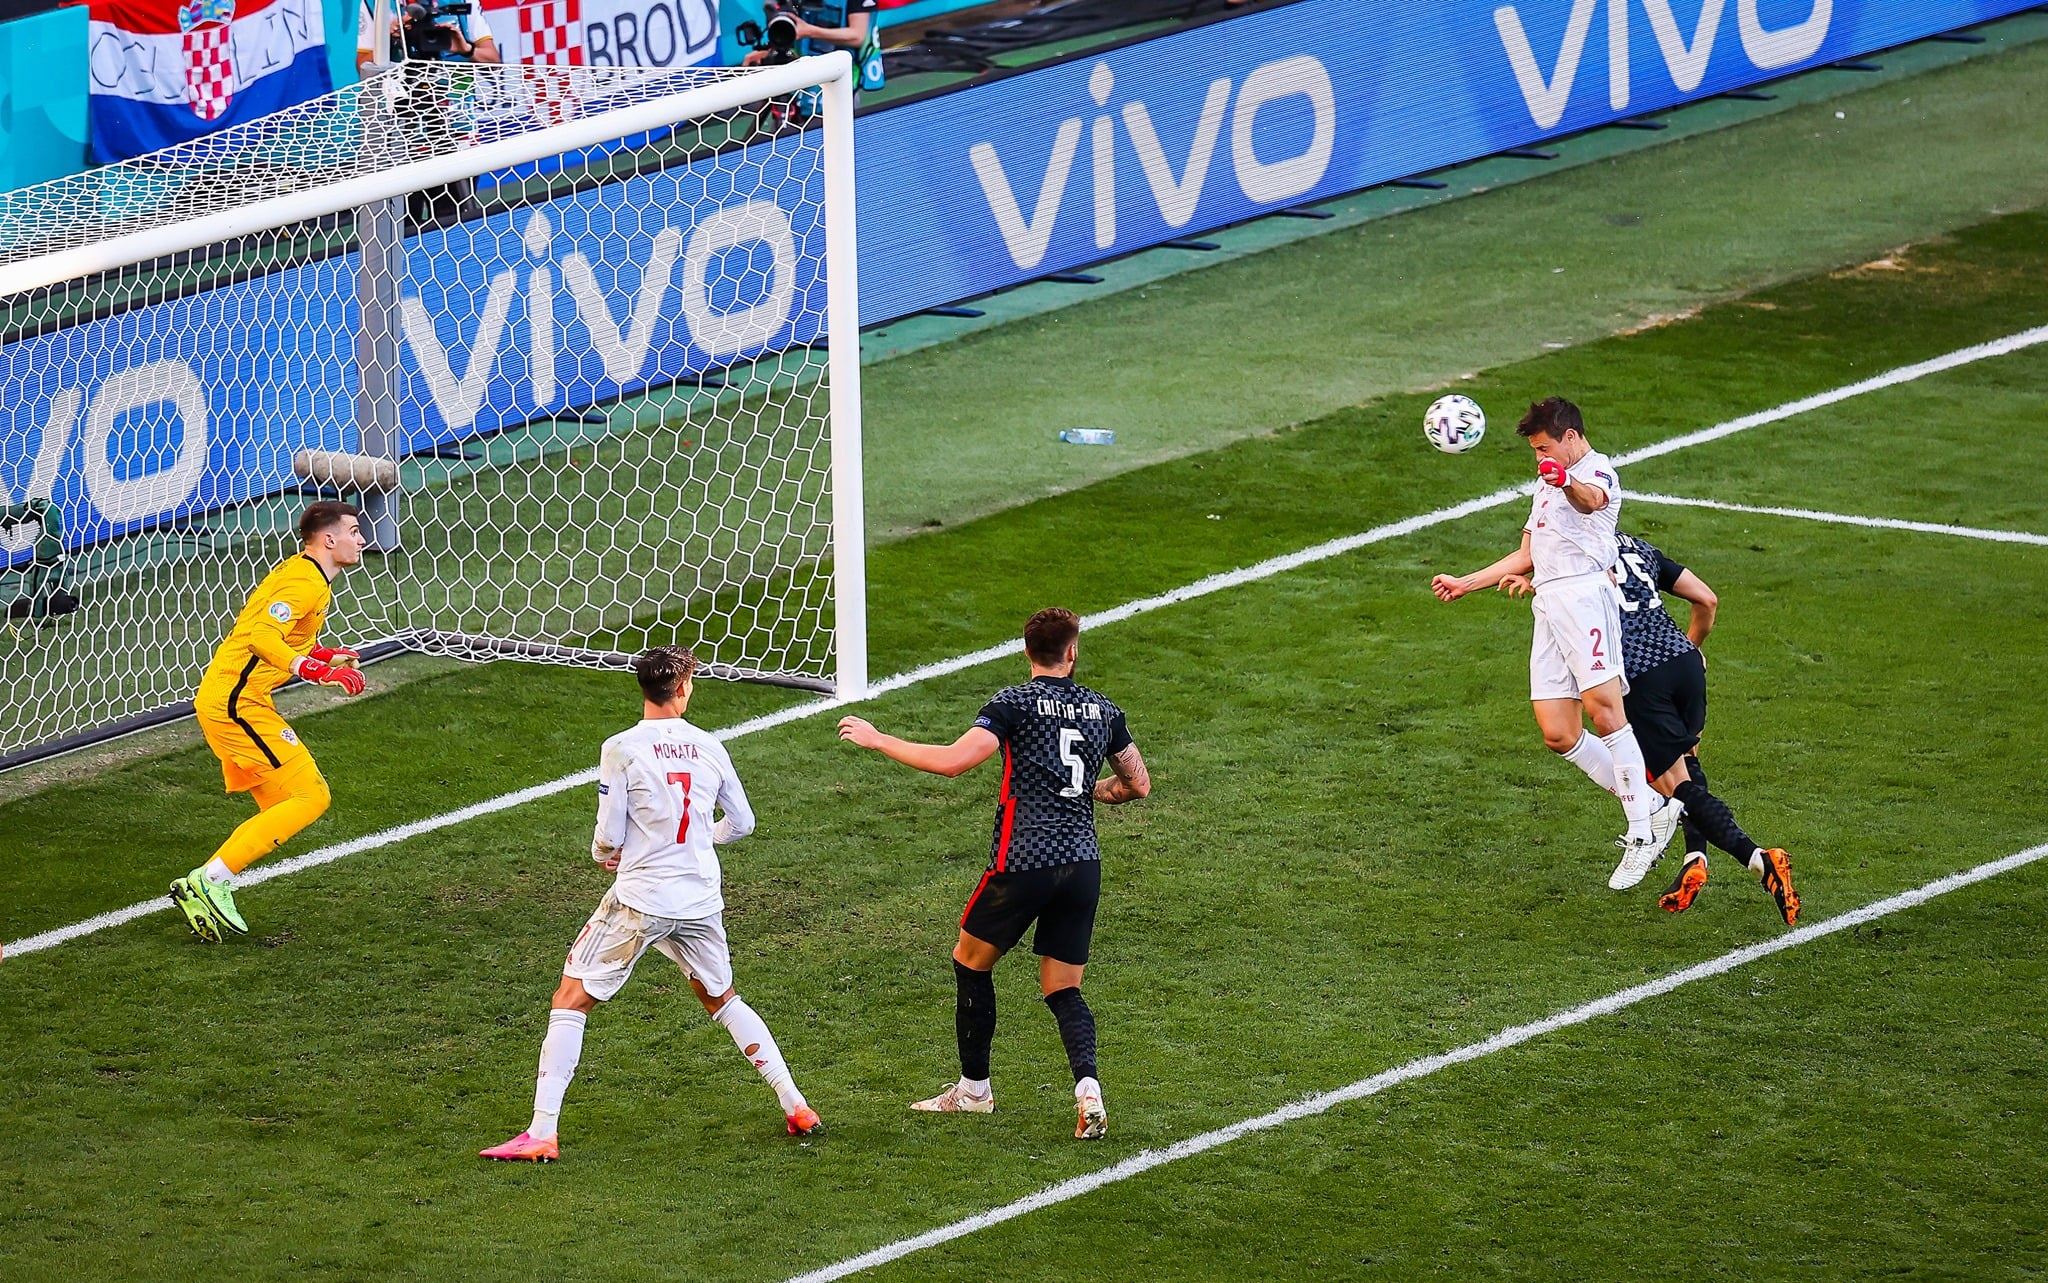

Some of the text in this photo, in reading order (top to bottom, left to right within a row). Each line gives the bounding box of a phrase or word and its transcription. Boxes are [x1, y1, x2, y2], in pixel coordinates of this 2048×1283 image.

[587, 0, 717, 87] BROD
[969, 61, 1336, 270] vivo
[401, 207, 797, 430] vivo
[1590, 628, 1604, 657] 2
[653, 743, 699, 760] MORATA
[1059, 727, 1086, 798] 5
[666, 772, 692, 844] 7
